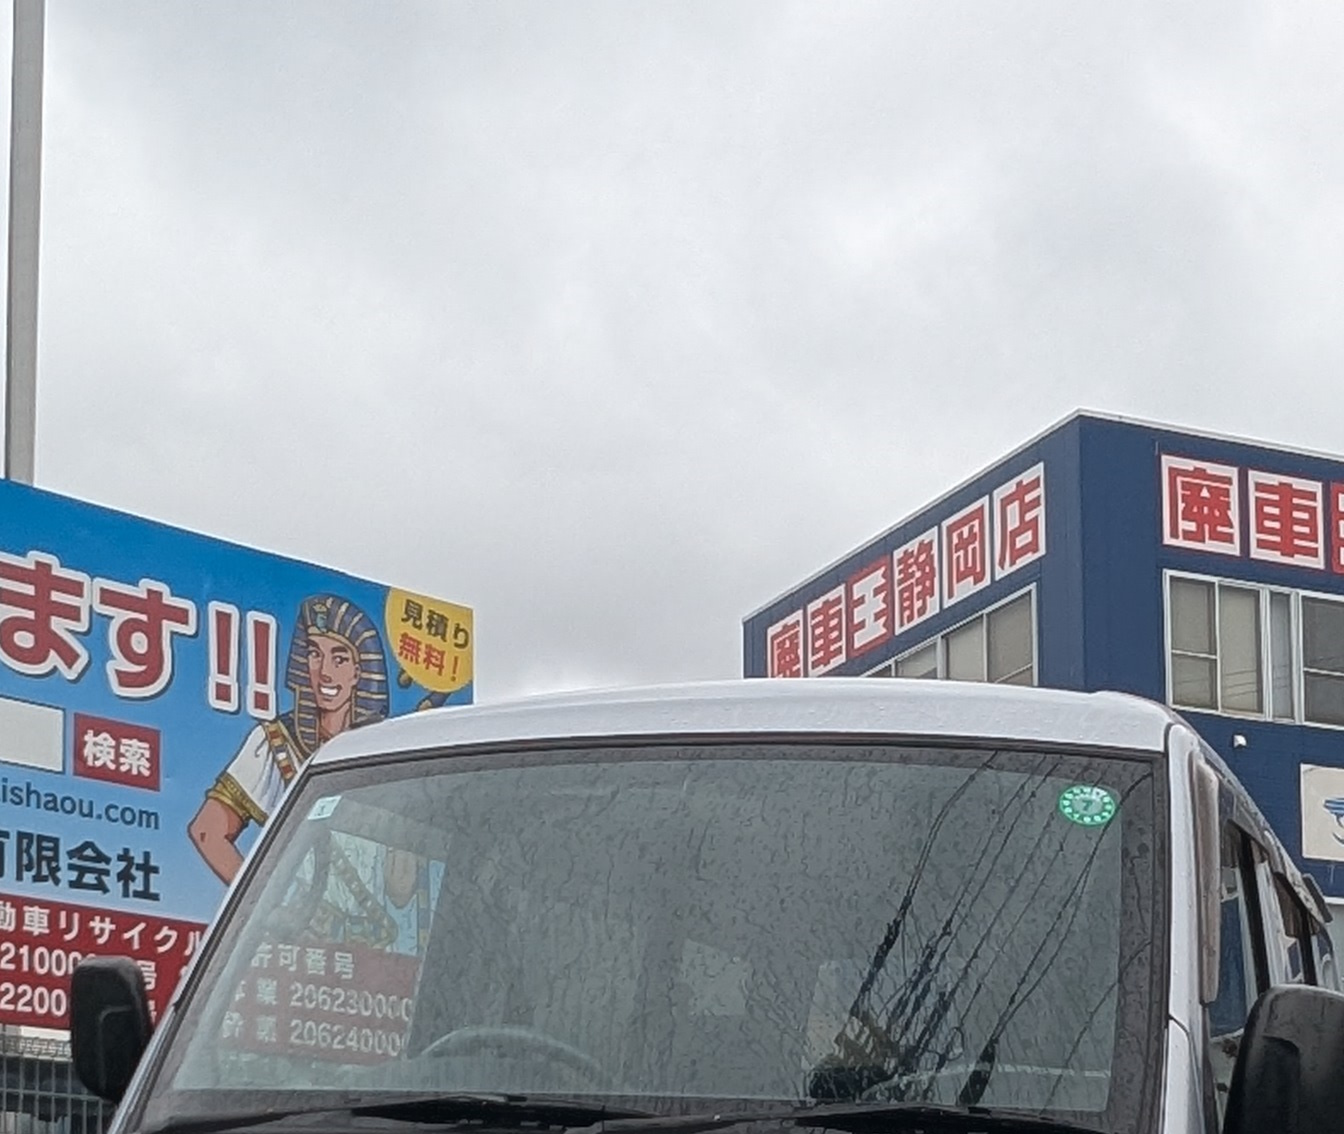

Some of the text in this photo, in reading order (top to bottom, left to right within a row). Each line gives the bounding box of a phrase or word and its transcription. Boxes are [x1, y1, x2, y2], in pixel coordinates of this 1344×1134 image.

[767, 464, 1045, 678] 廃車王静岡店
[401, 598, 470, 649] 見積り
[83, 729, 152, 778] 検索
